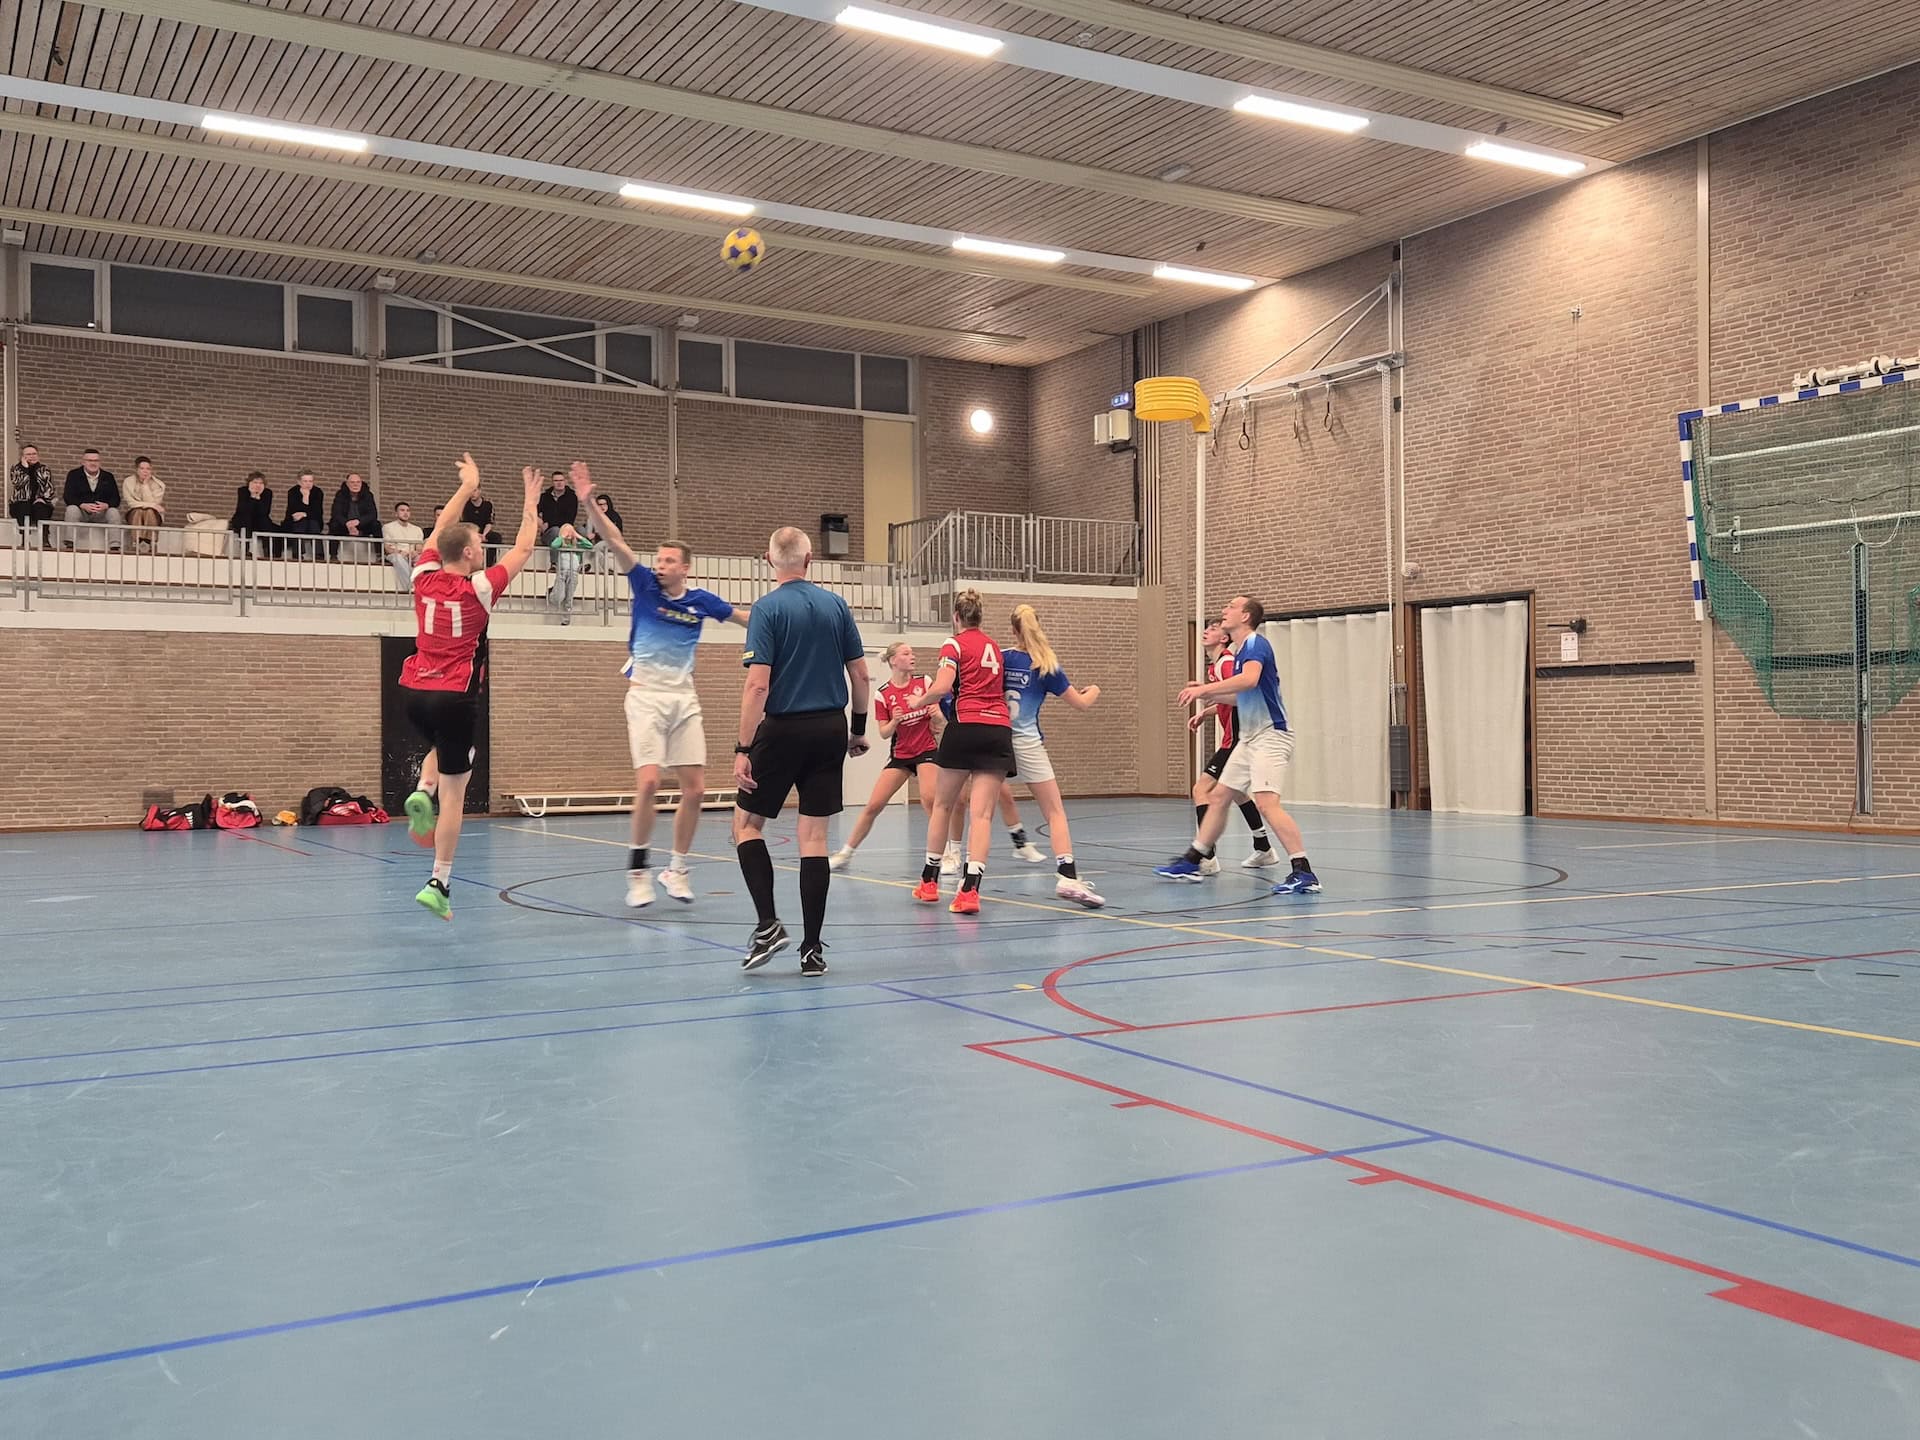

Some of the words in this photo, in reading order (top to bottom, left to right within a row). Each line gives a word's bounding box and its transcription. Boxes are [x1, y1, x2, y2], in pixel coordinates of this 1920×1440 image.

[421, 596, 463, 638] 11
[980, 643, 1000, 675] 4
[889, 695, 897, 706] 2
[1004, 689, 1021, 720] 6
